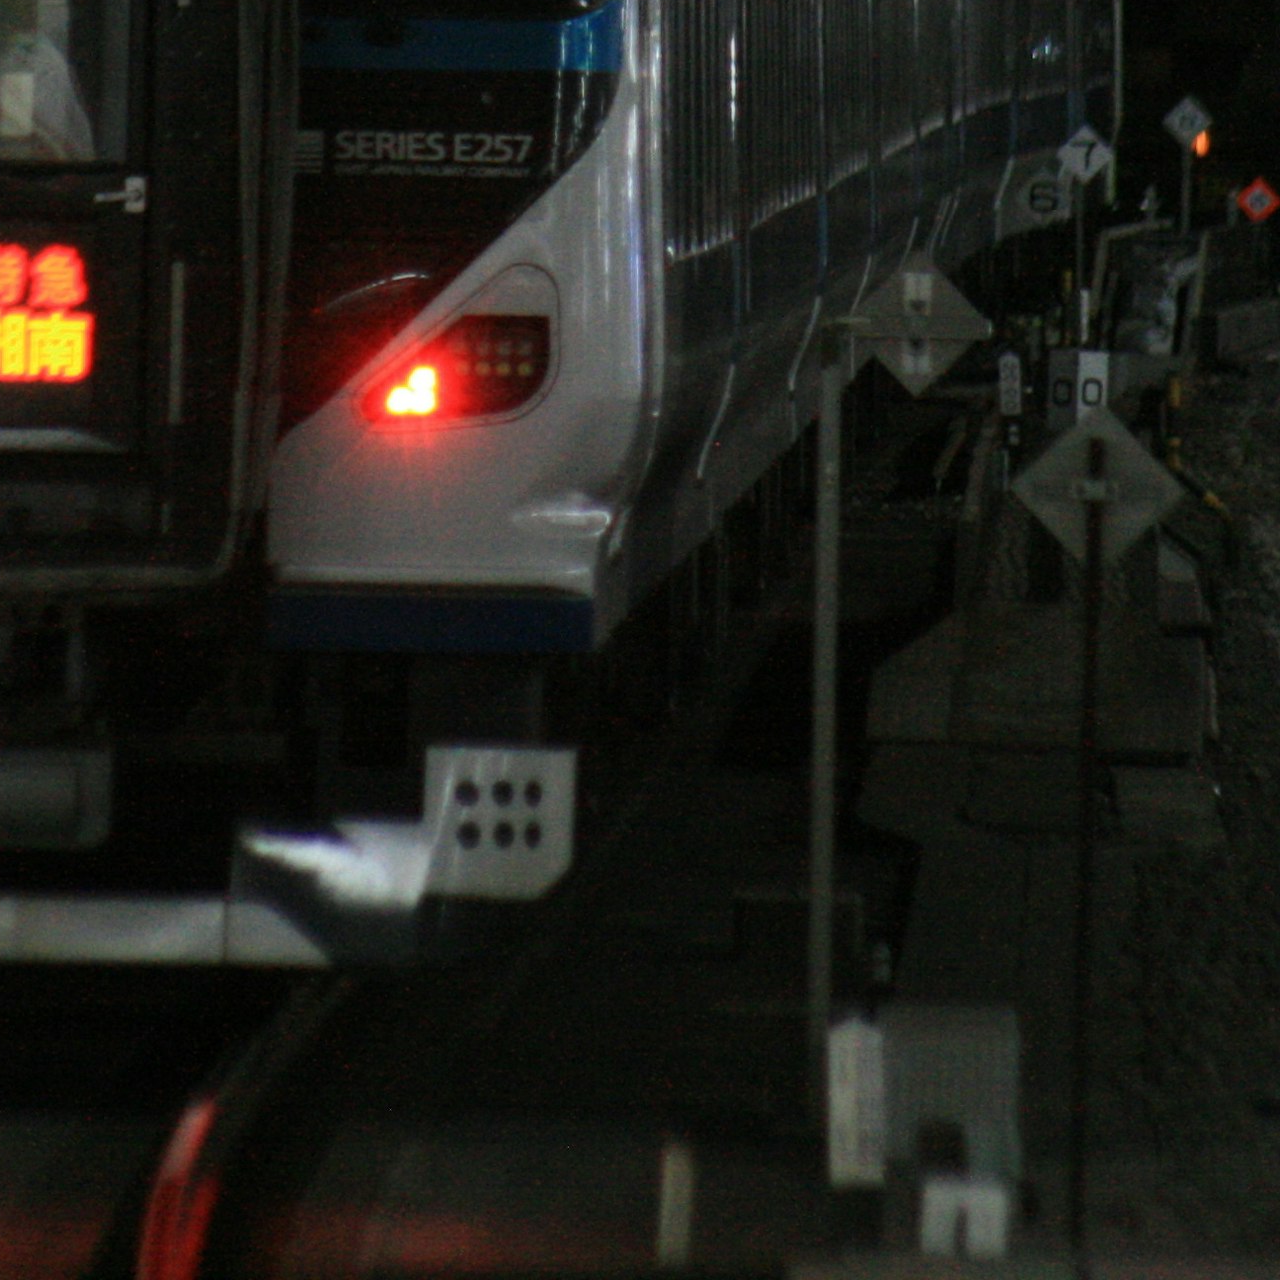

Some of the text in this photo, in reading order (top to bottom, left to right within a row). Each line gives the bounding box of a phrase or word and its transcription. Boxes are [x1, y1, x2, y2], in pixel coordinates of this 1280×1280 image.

[335, 130, 533, 163] SERIES E257
[1069, 140, 1095, 170] 7
[1029, 179, 1058, 212] 6
